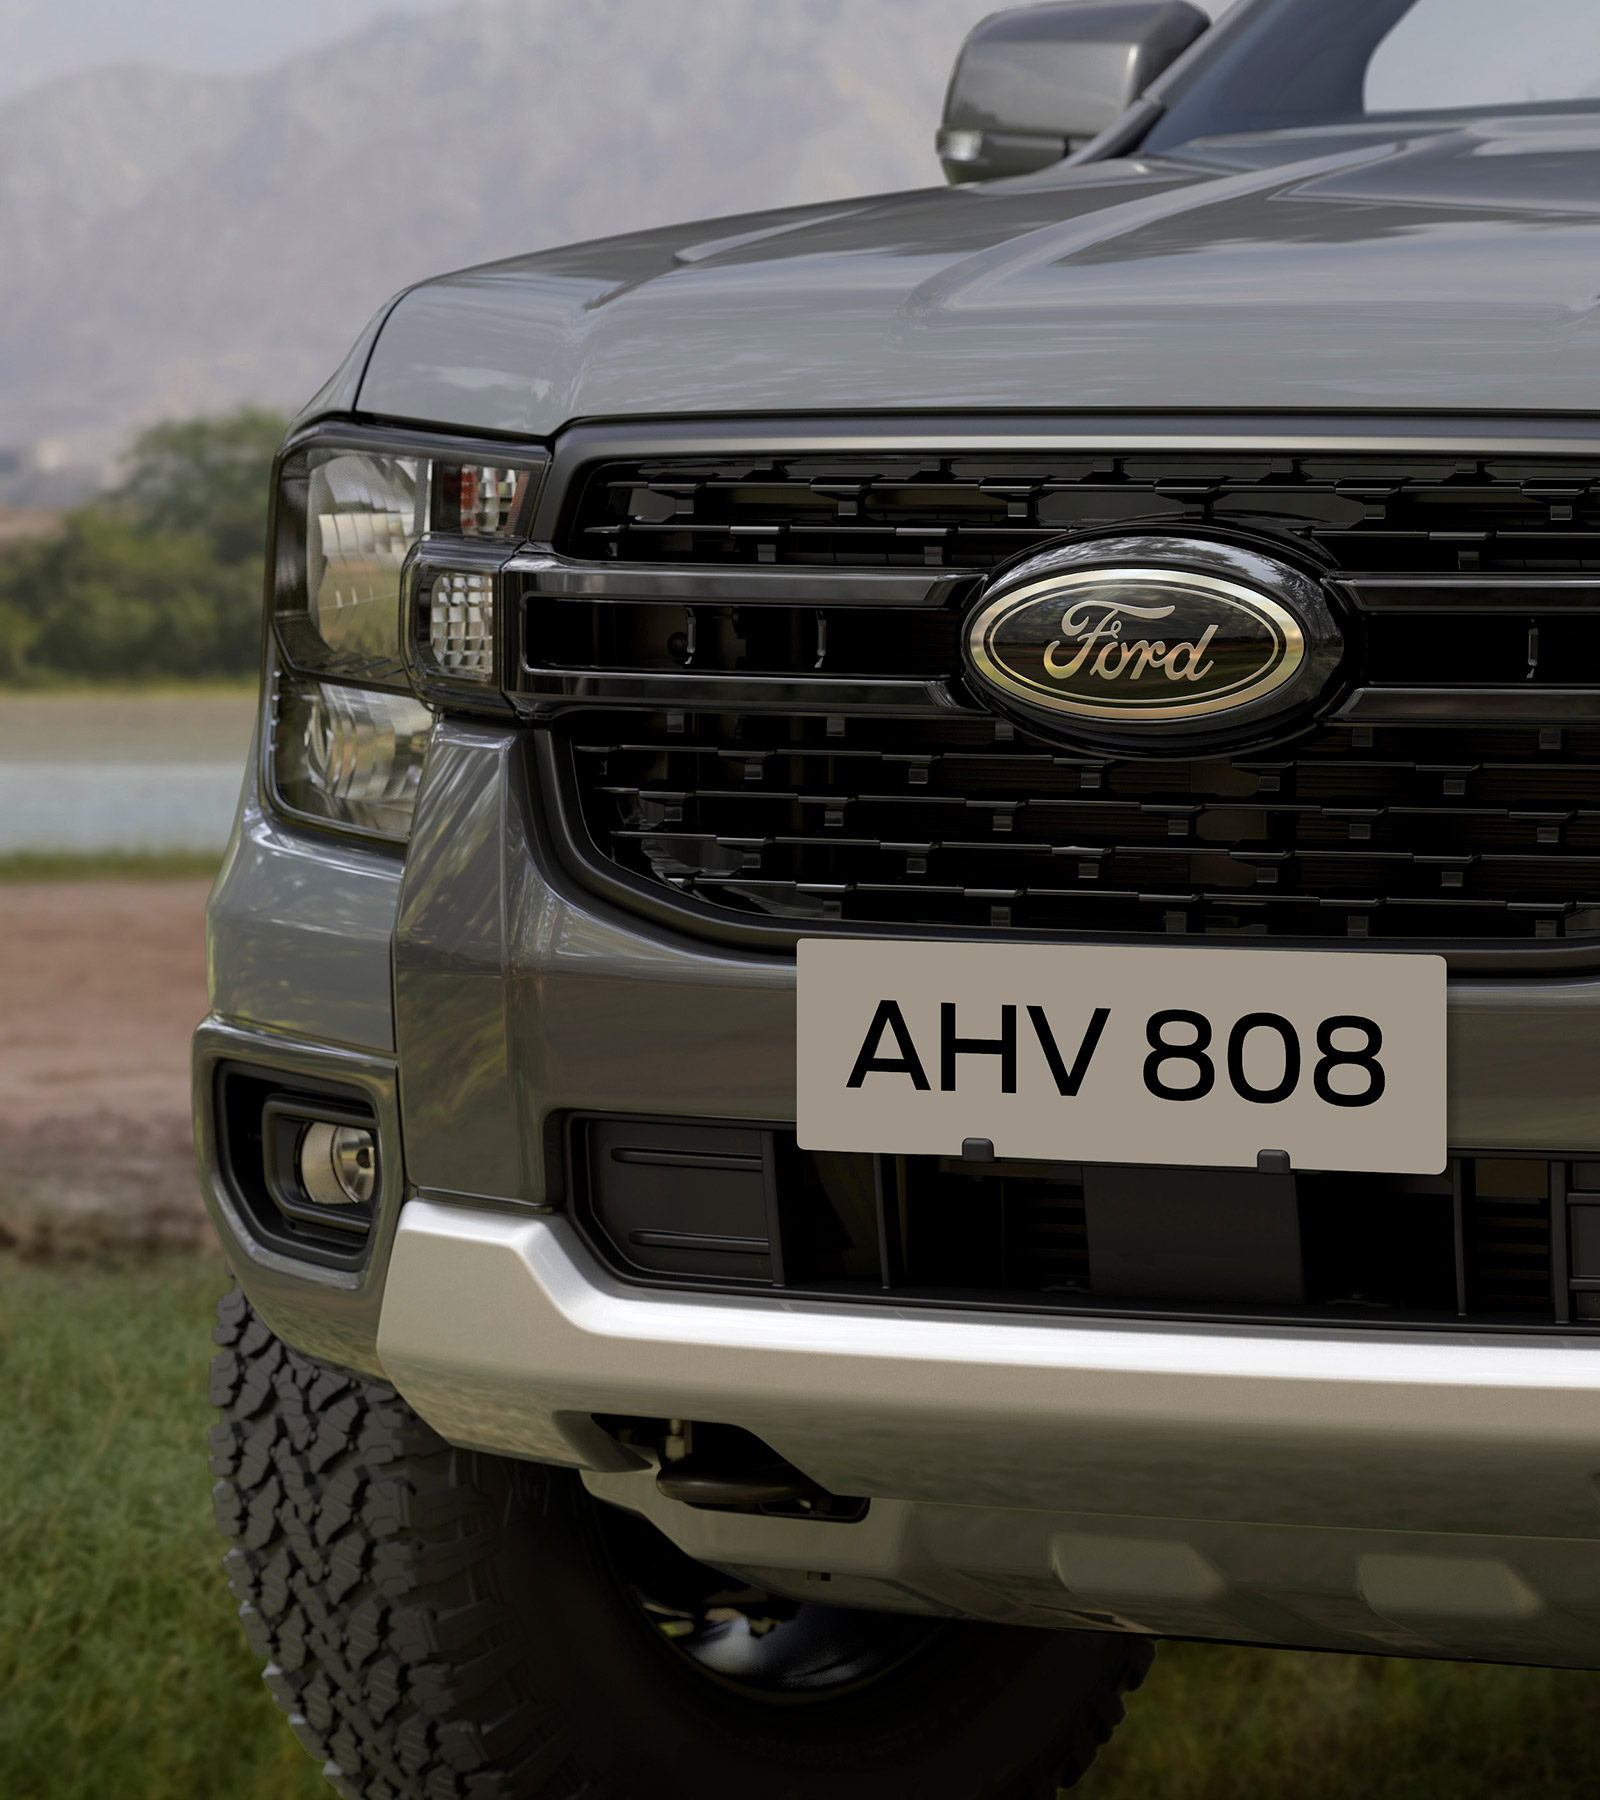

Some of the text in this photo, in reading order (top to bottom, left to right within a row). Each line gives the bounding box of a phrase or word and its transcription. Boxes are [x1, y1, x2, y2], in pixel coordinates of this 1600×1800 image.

[1043, 599, 1219, 682] Ford
[846, 1000, 1385, 1107] AHV 808
